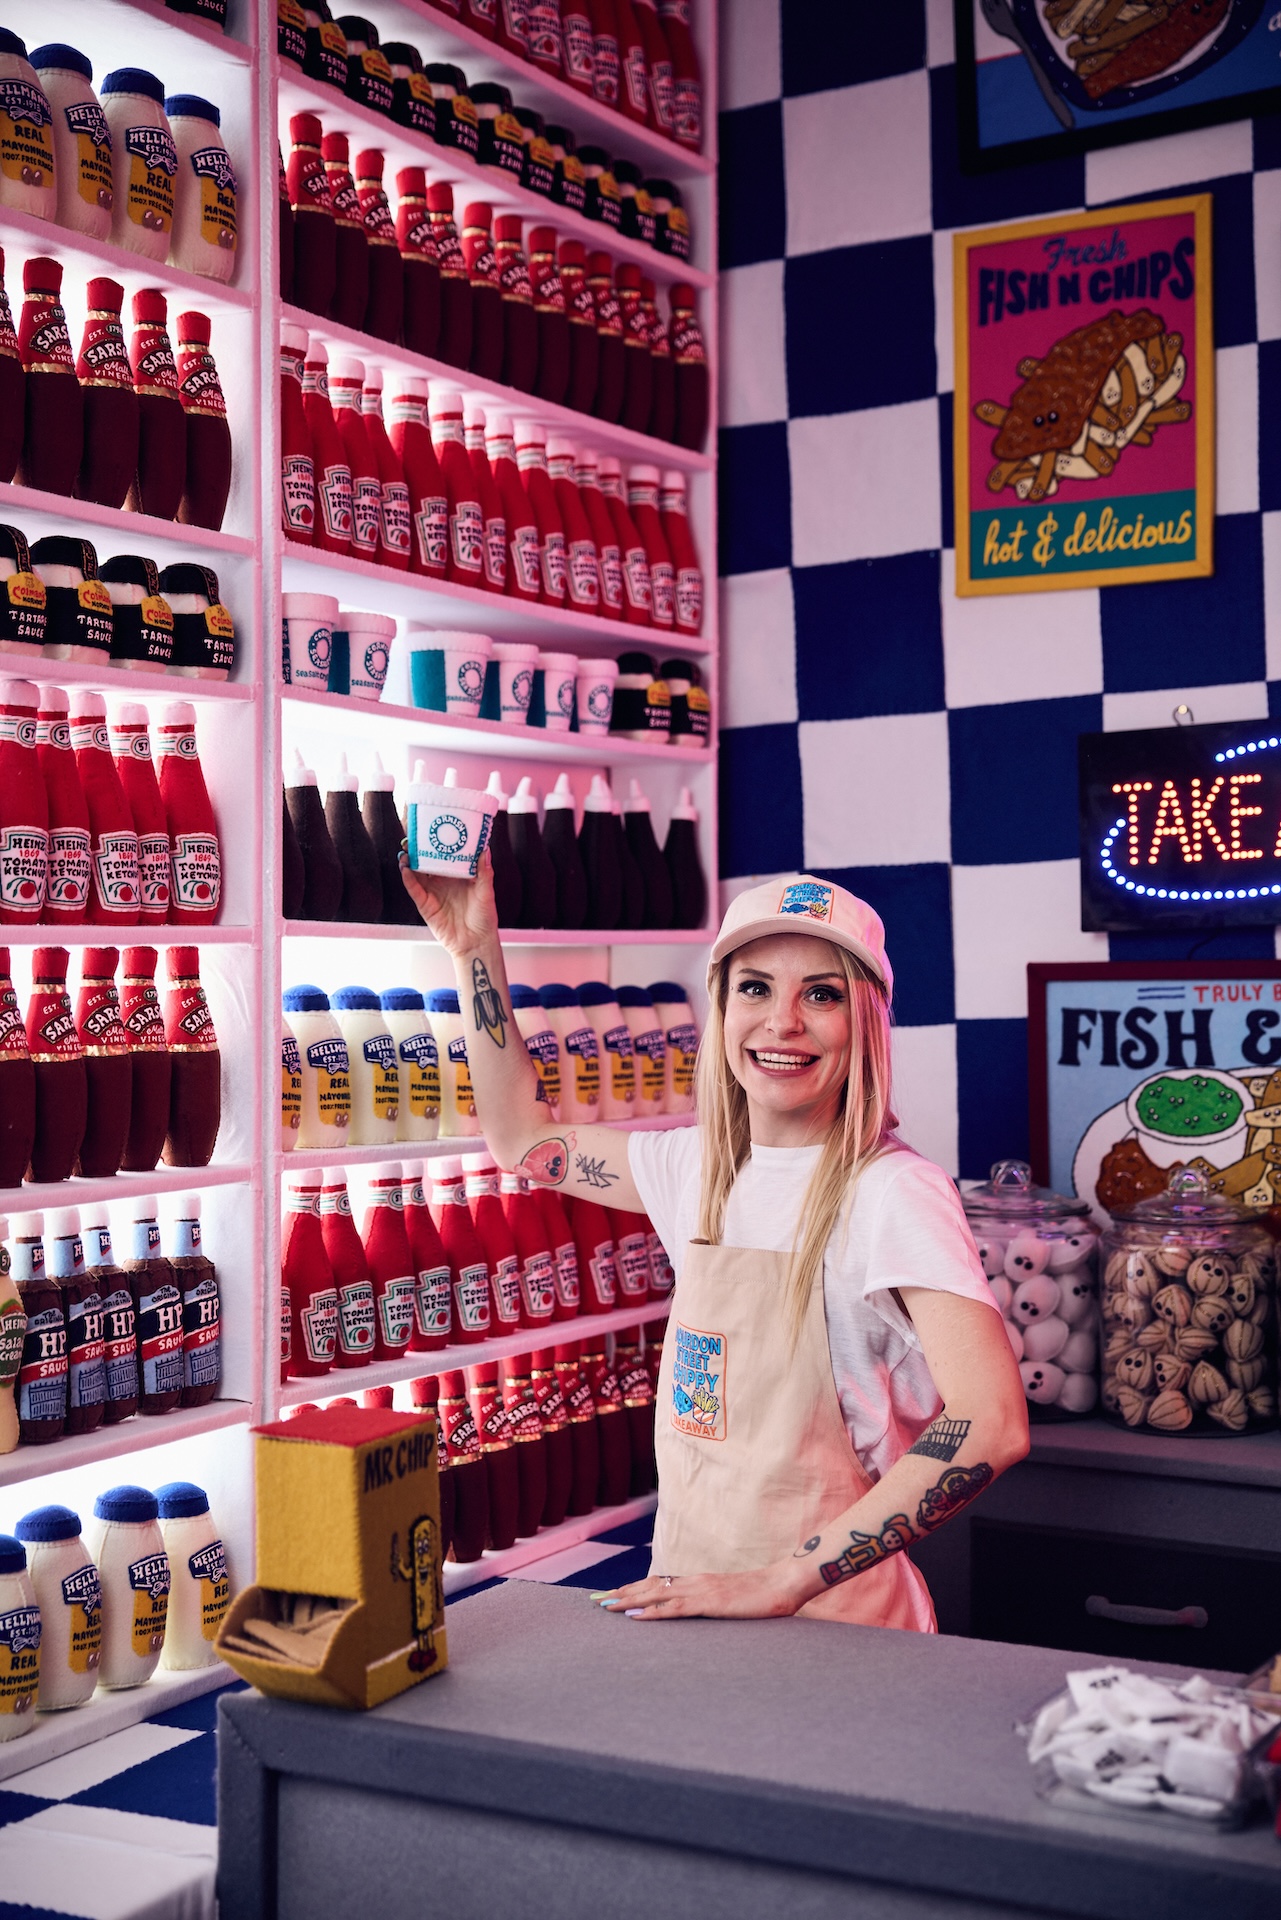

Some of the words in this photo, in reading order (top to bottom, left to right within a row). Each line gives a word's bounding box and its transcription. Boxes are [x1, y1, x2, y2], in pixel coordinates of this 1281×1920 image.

[14, 125, 44, 143] REAL
[147, 172, 173, 193] REAL
[1043, 229, 1127, 271] Fresh
[978, 267, 1049, 327] FISH
[1058, 272, 1081, 305] N
[1088, 237, 1195, 303] CHIPS
[33, 311, 50, 323] EST.
[88, 329, 104, 342] EST.
[140, 338, 157, 349] EST.
[182, 358, 200, 371] EST.
[984, 519, 1028, 566] hot
[1063, 506, 1193, 556] delicious
[18, 624, 44, 639] SAUCE
[87, 629, 112, 643] SAUCE
[59, 729, 70, 741] 57
[138, 741, 149, 751] 57
[184, 741, 195, 751] 57
[1112, 773, 1263, 866] TAKE
[12, 838, 46, 851] HEINZ
[56, 840, 87, 851] HEINZ
[187, 844, 216, 854] HEINZ
[437, 844, 458, 854] SALT
[20, 849, 40, 858] 1869
[63, 850, 81, 859] 1869
[194, 854, 212, 862] 1869
[87, 994, 104, 1006] EST.
[1193, 984, 1263, 1003] TRULY
[43, 1003, 59, 1014] EST.
[124, 996, 142, 1008] EST.
[181, 997, 197, 1008] EST.
[0, 1010, 21, 1038] ARS
[1057, 1006, 1215, 1070] FISH
[1241, 1009, 1281, 1066] &
[330, 1078, 349, 1088] REAL
[157, 1303, 183, 1332] HP
[199, 1298, 219, 1324] HP
[111, 1310, 135, 1336] HP
[39, 1331, 66, 1357] HP
[676, 1345, 710, 1371] STREET
[673, 1361, 719, 1393] CHIPPY
[364, 1446, 394, 1493] MR
[396, 1432, 435, 1479] CHIP
[10, 1654, 37, 1670] REAL
